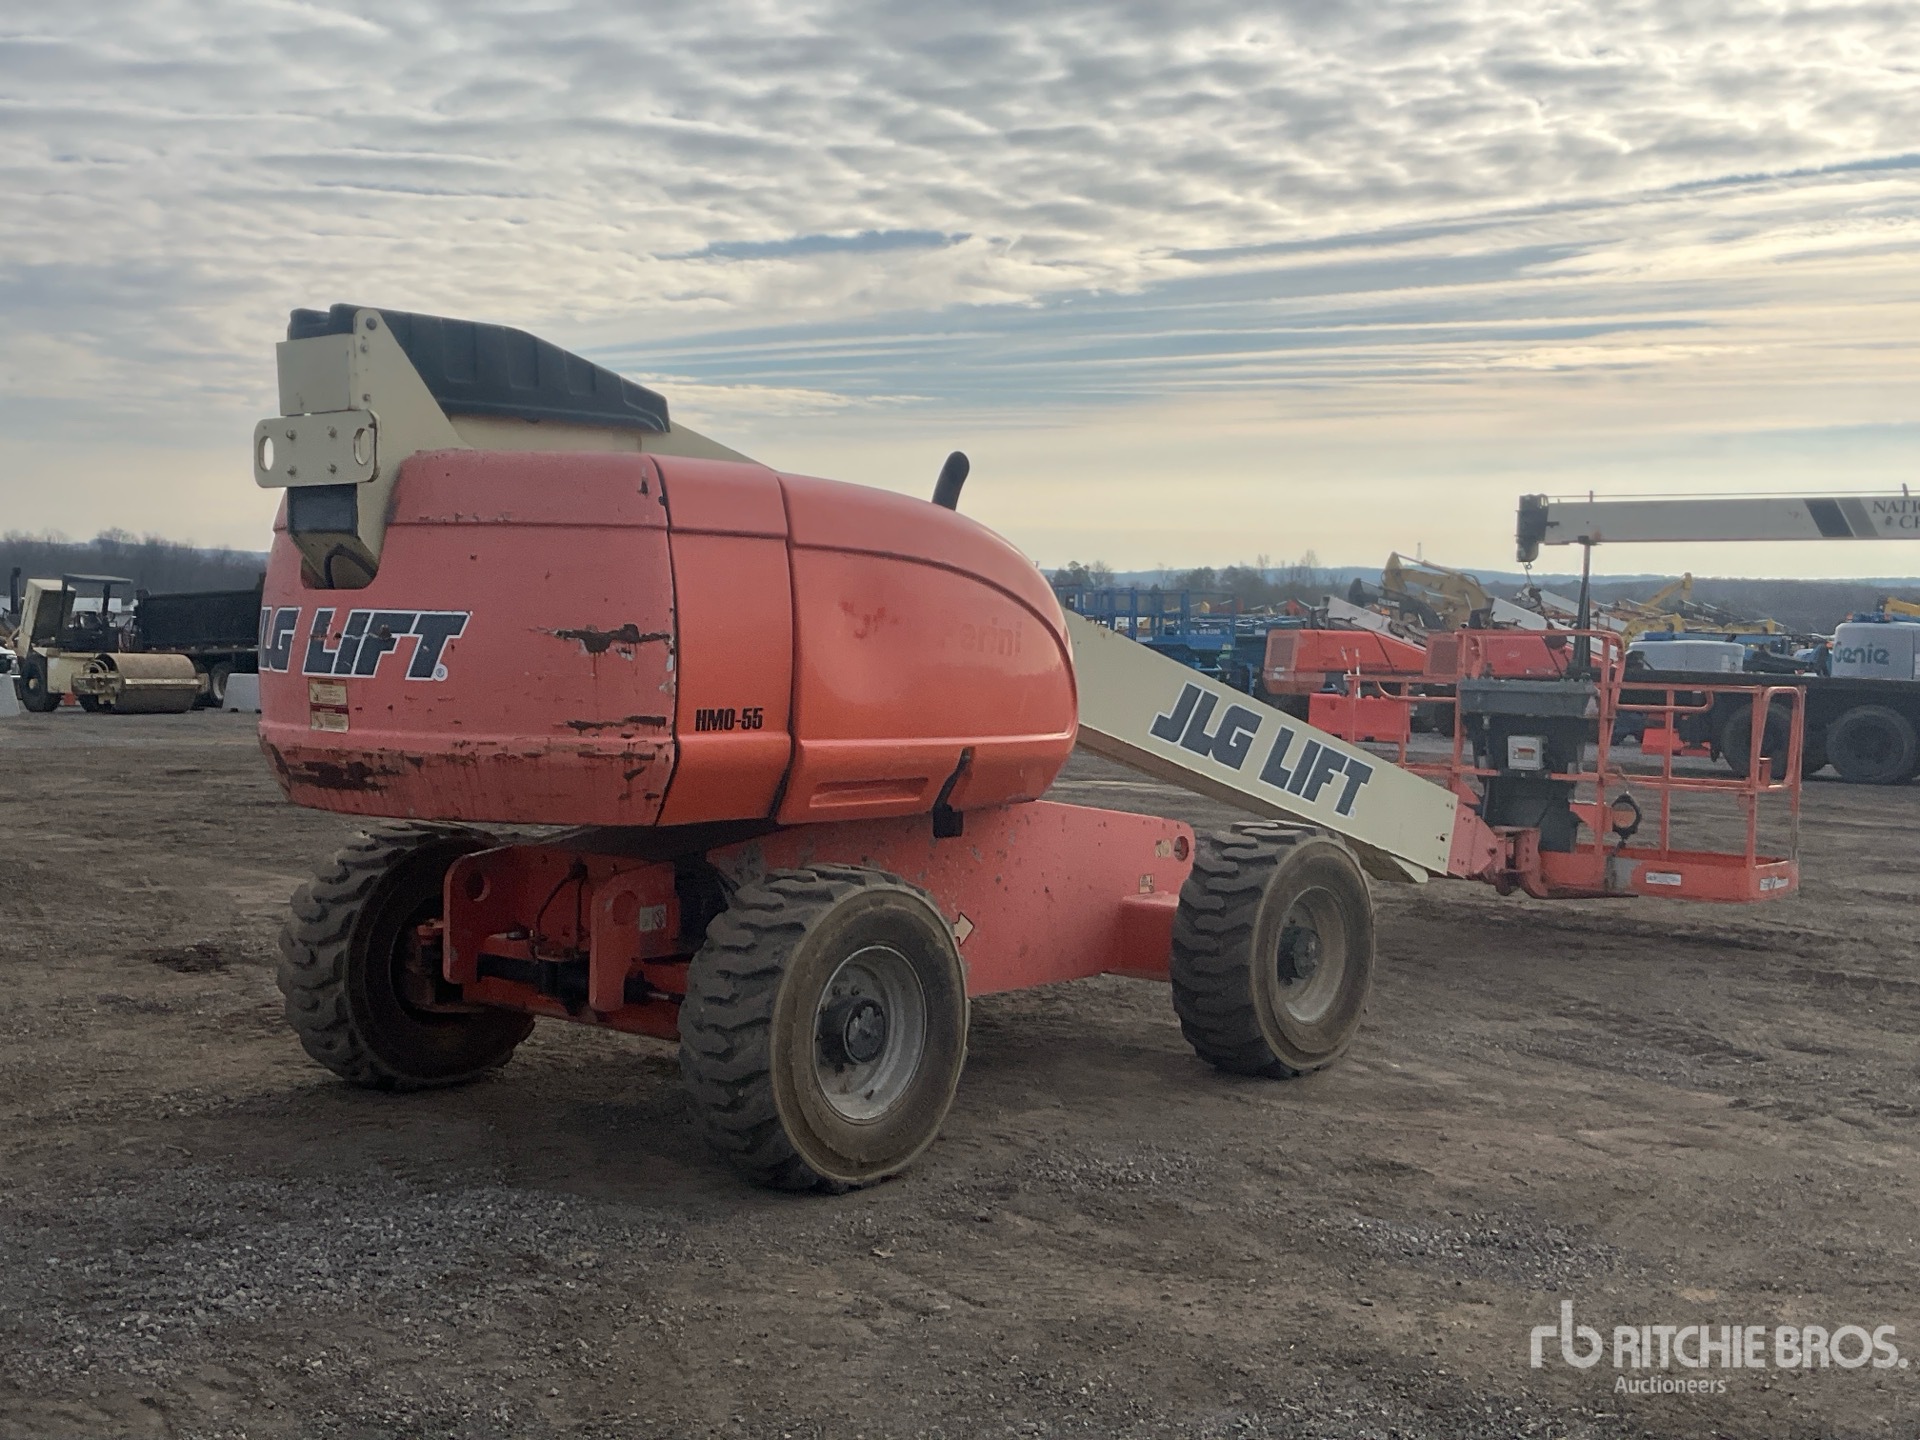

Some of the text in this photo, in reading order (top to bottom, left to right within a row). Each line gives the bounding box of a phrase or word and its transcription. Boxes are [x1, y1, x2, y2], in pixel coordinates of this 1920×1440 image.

[1872, 500, 1920, 513] NATI
[259, 606, 474, 681] LG LIFT
[695, 707, 764, 731] HMO-55
[1148, 681, 1375, 819] JLG LIFT
